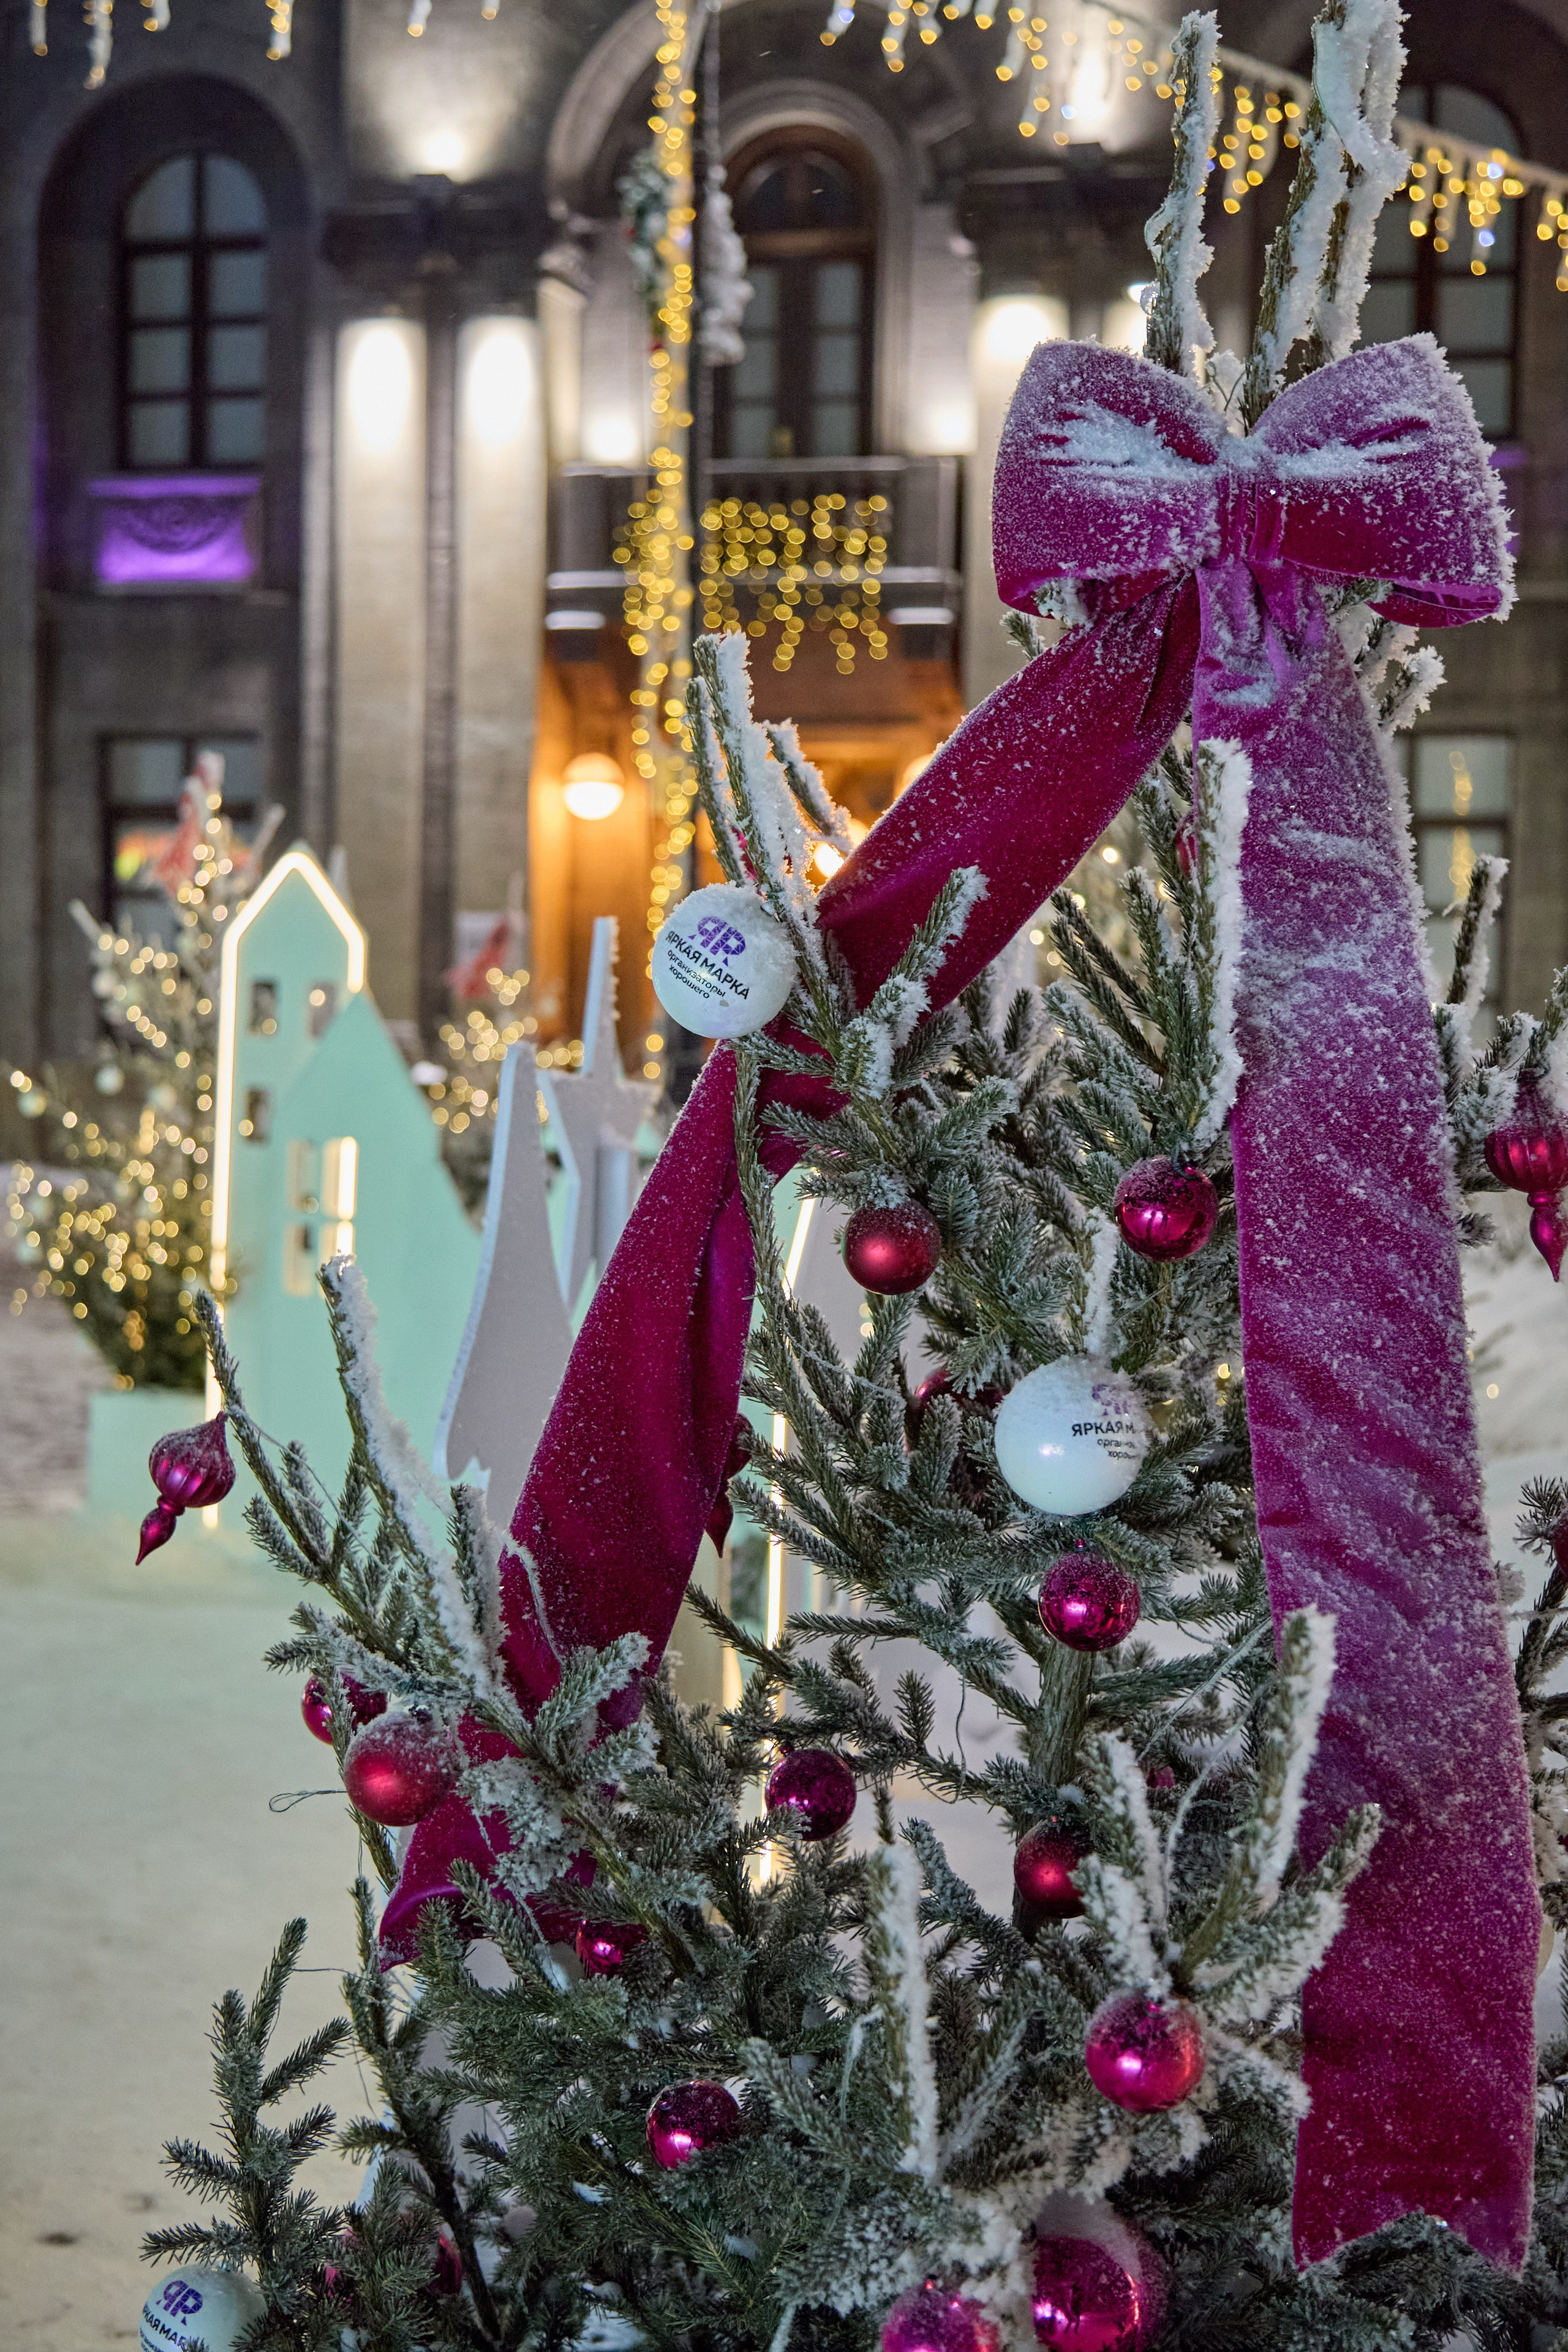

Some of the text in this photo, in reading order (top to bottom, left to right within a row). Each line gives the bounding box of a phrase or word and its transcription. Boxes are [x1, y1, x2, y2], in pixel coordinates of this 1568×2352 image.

[665, 930, 750, 1000] ЯРКАЯ МАРКА
[667, 949, 726, 997] организаторы
[669, 964, 710, 999] хорошего
[1071, 1421, 1124, 1437] ЯРКАЯ
